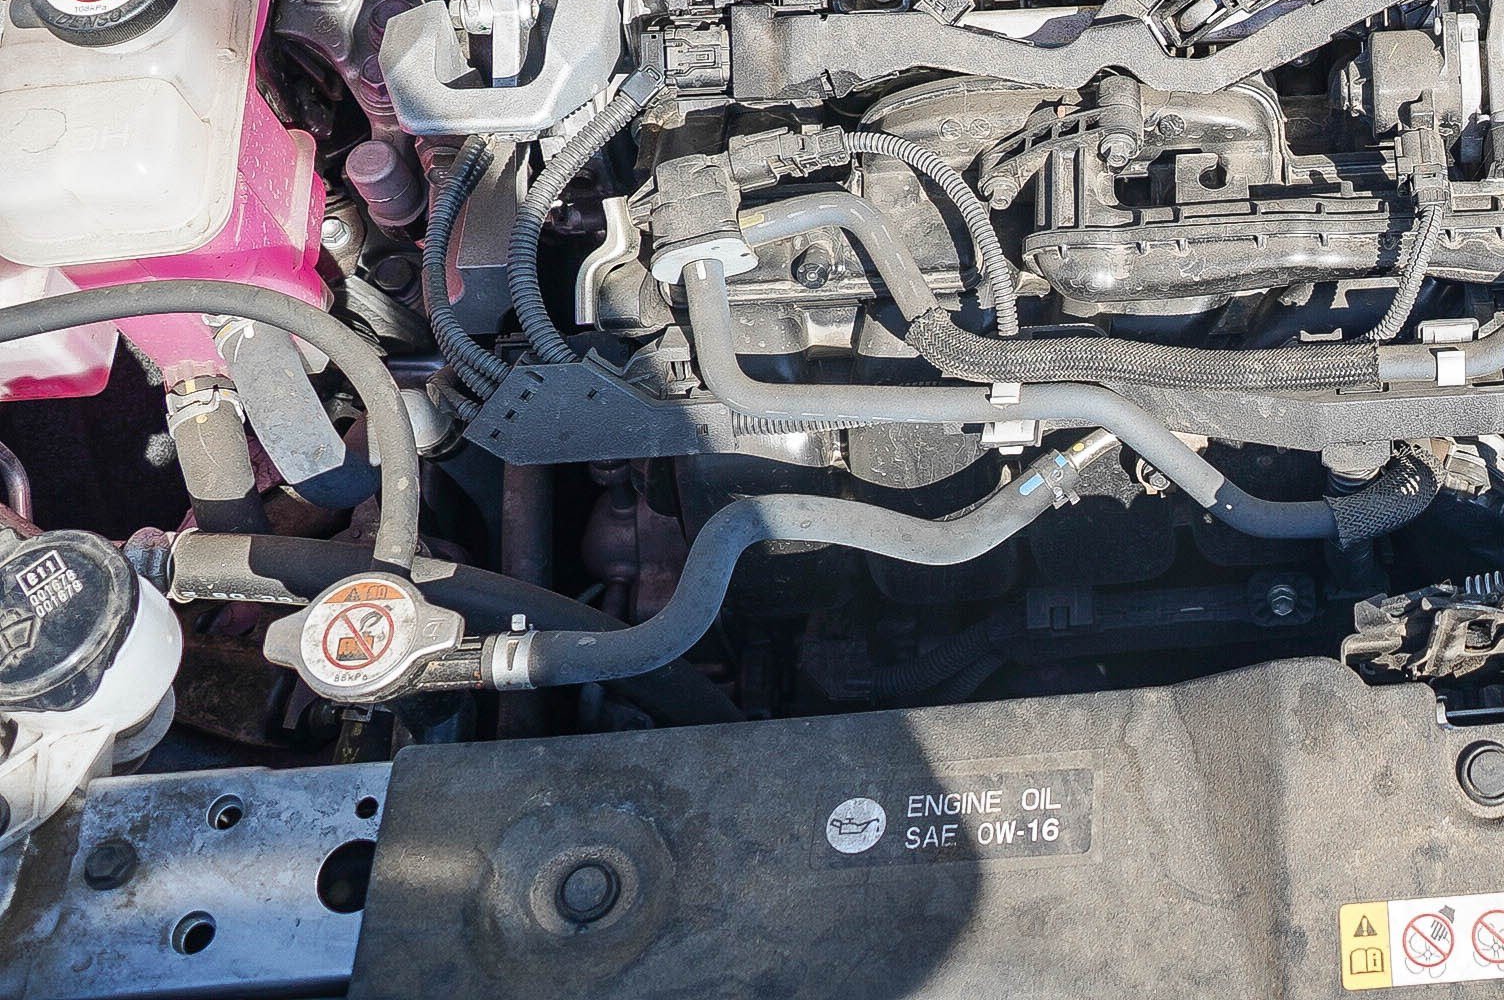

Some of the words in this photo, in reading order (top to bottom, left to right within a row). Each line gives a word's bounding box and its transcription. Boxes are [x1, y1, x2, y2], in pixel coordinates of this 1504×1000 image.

[54, 8, 123, 28] DENSO
[906, 789, 1003, 818] ENGINE
[1020, 787, 1062, 812] OIL
[904, 823, 959, 850] SAE
[976, 817, 1060, 846] 0W-16
